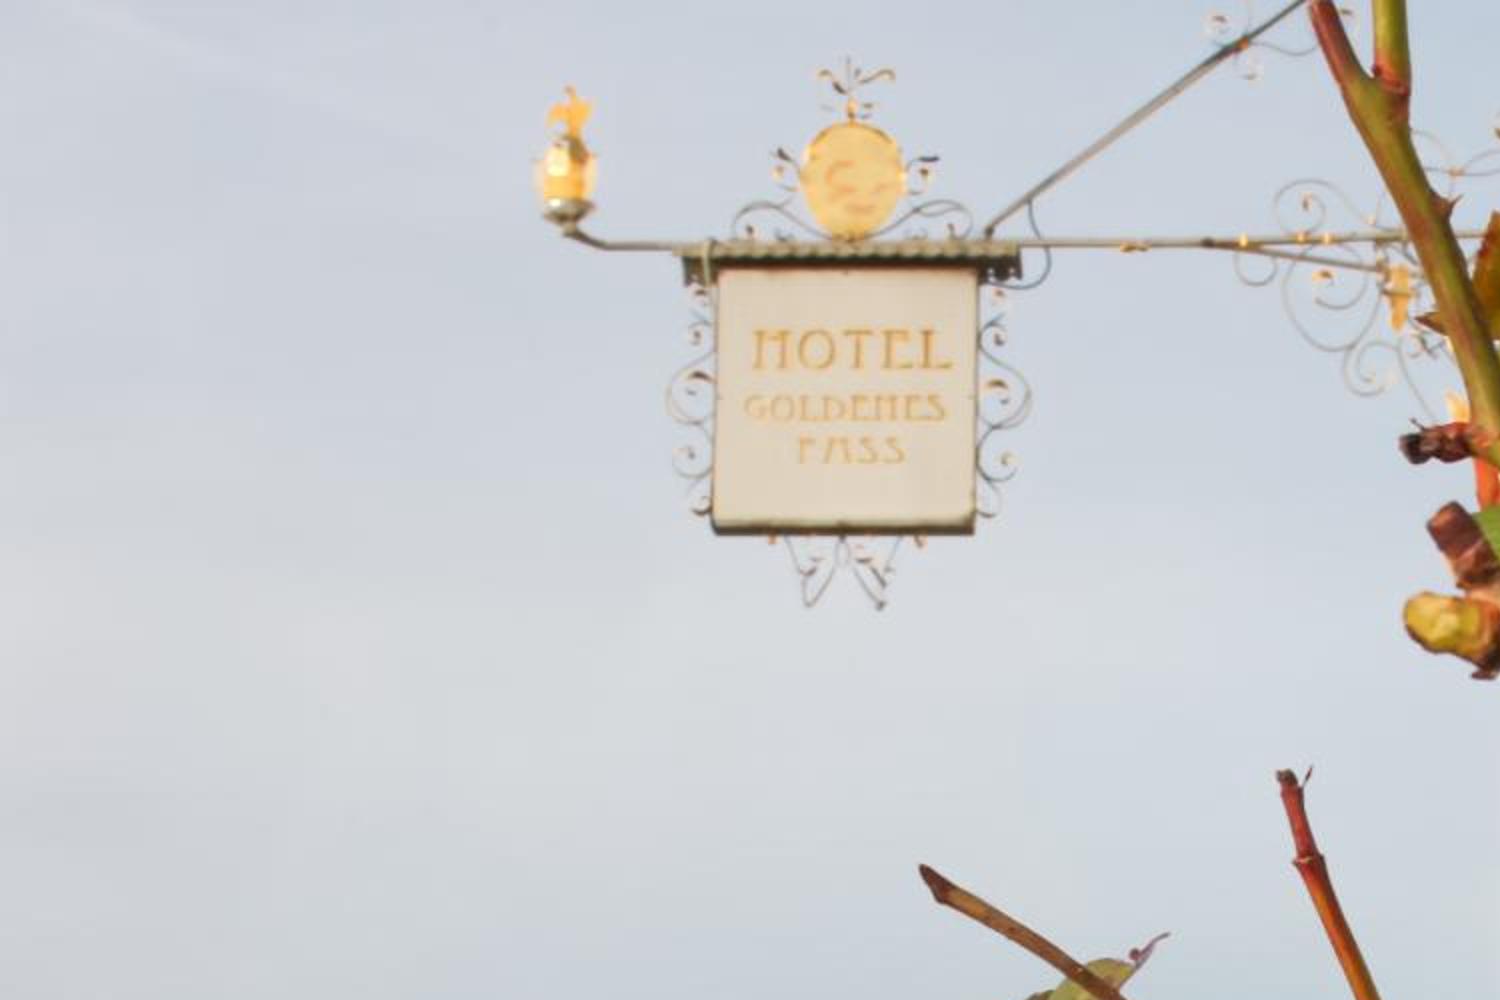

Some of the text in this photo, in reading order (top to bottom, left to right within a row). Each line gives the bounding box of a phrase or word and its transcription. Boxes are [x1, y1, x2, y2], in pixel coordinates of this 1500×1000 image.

[752, 328, 954, 370] HOTEL
[744, 393, 947, 422] GOLDENES
[797, 435, 905, 464] FASS
